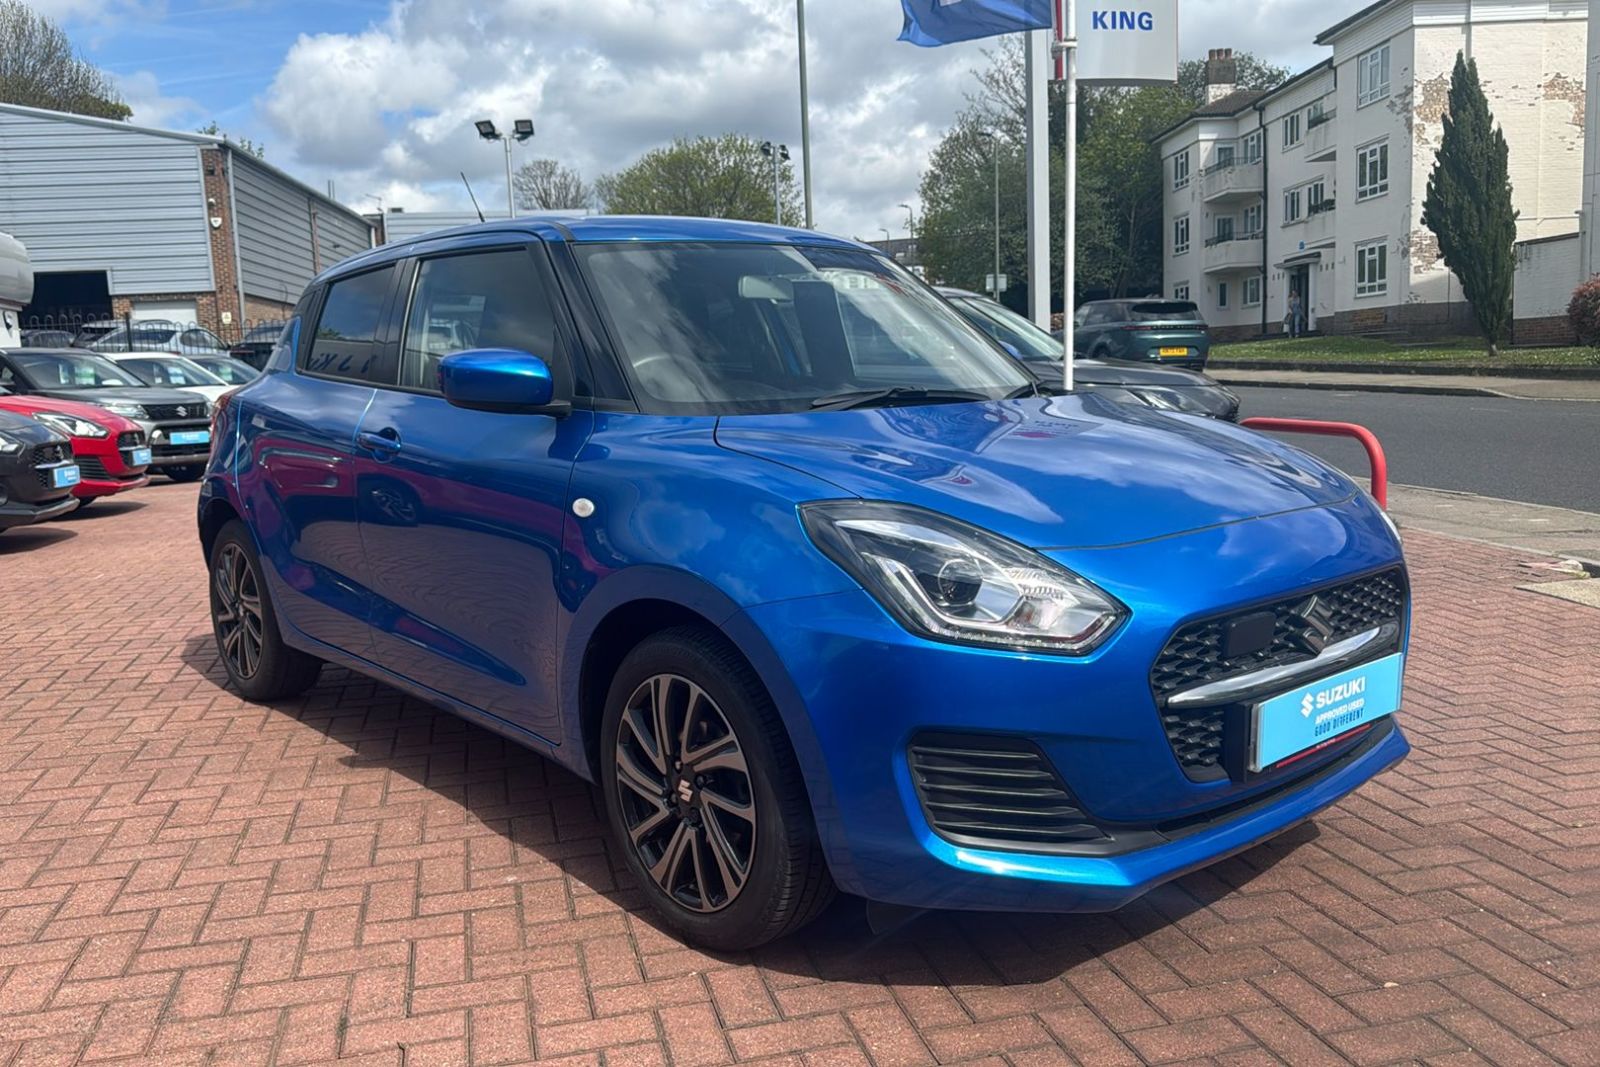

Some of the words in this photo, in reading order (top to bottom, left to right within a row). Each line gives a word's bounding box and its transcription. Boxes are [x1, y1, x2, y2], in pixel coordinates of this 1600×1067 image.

[1092, 10, 1153, 31] KING
[1316, 676, 1366, 709] SUZUKI
[1315, 704, 1348, 725] APPROVED
[1315, 721, 1331, 737] GOOD
[1333, 707, 1364, 729] DIFFERENT
